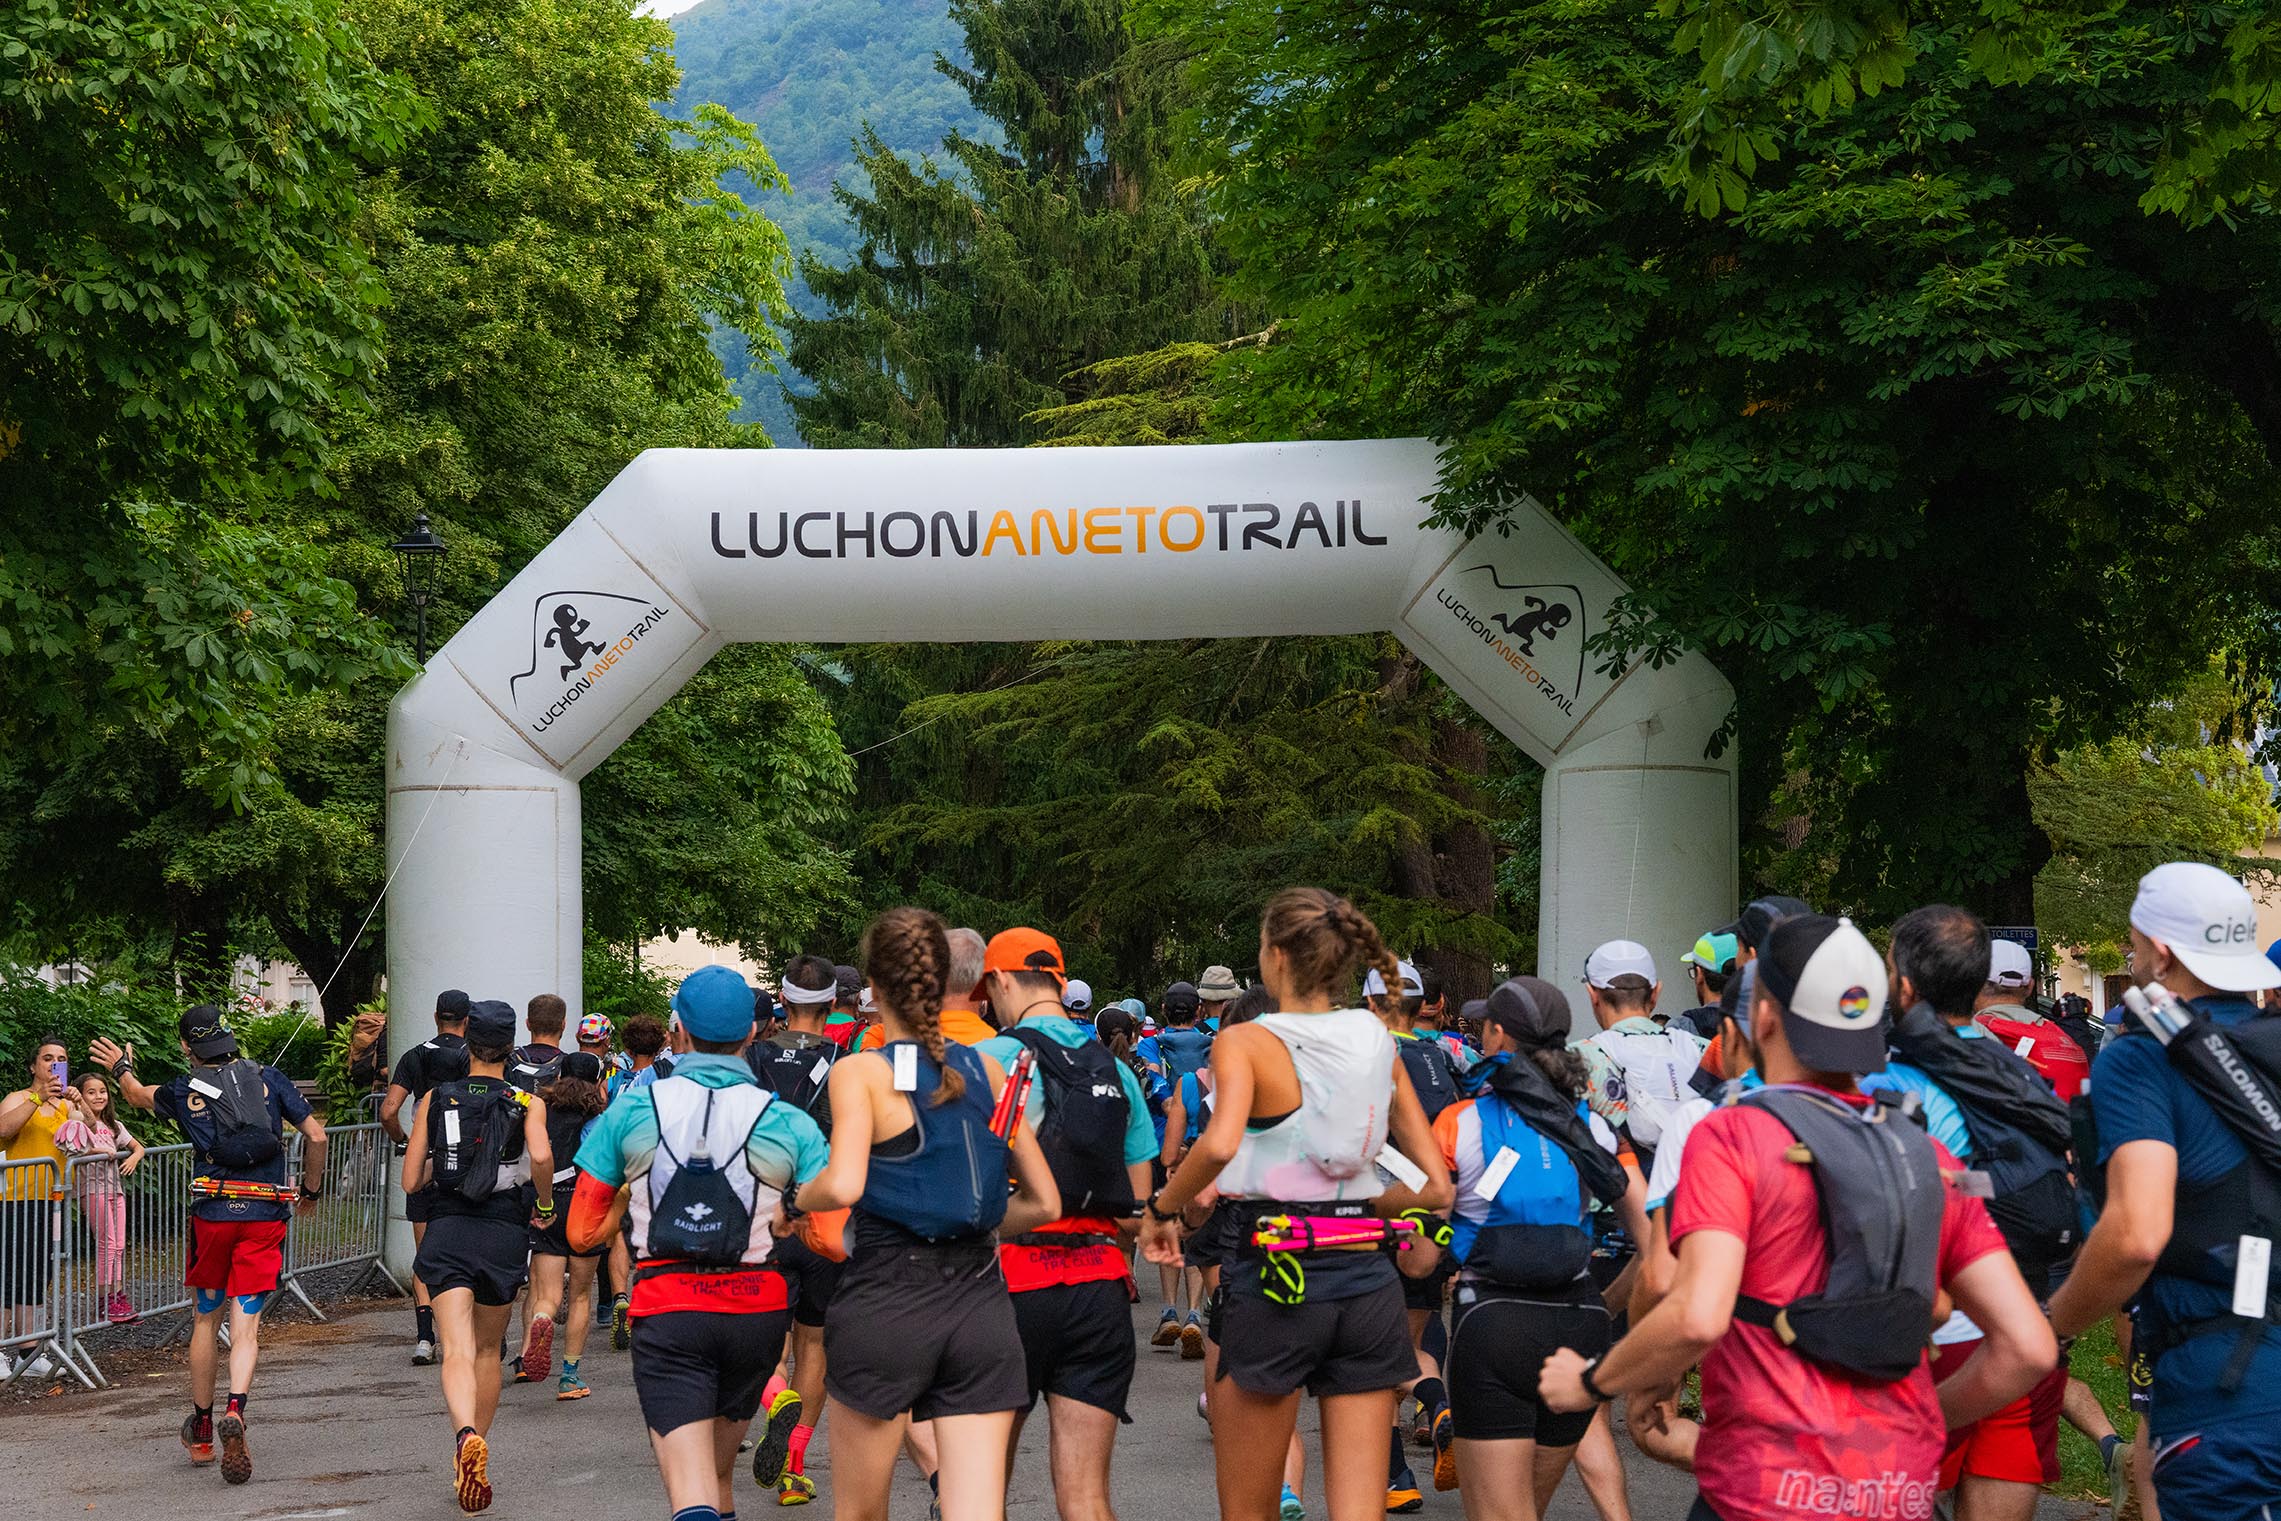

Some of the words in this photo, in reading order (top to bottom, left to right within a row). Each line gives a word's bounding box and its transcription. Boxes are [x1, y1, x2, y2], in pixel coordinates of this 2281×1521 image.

[1991, 929, 2034, 939] TOILETTES
[2203, 1033, 2281, 1132] SALOMON
[674, 1218, 722, 1233] RAIDLIGHT
